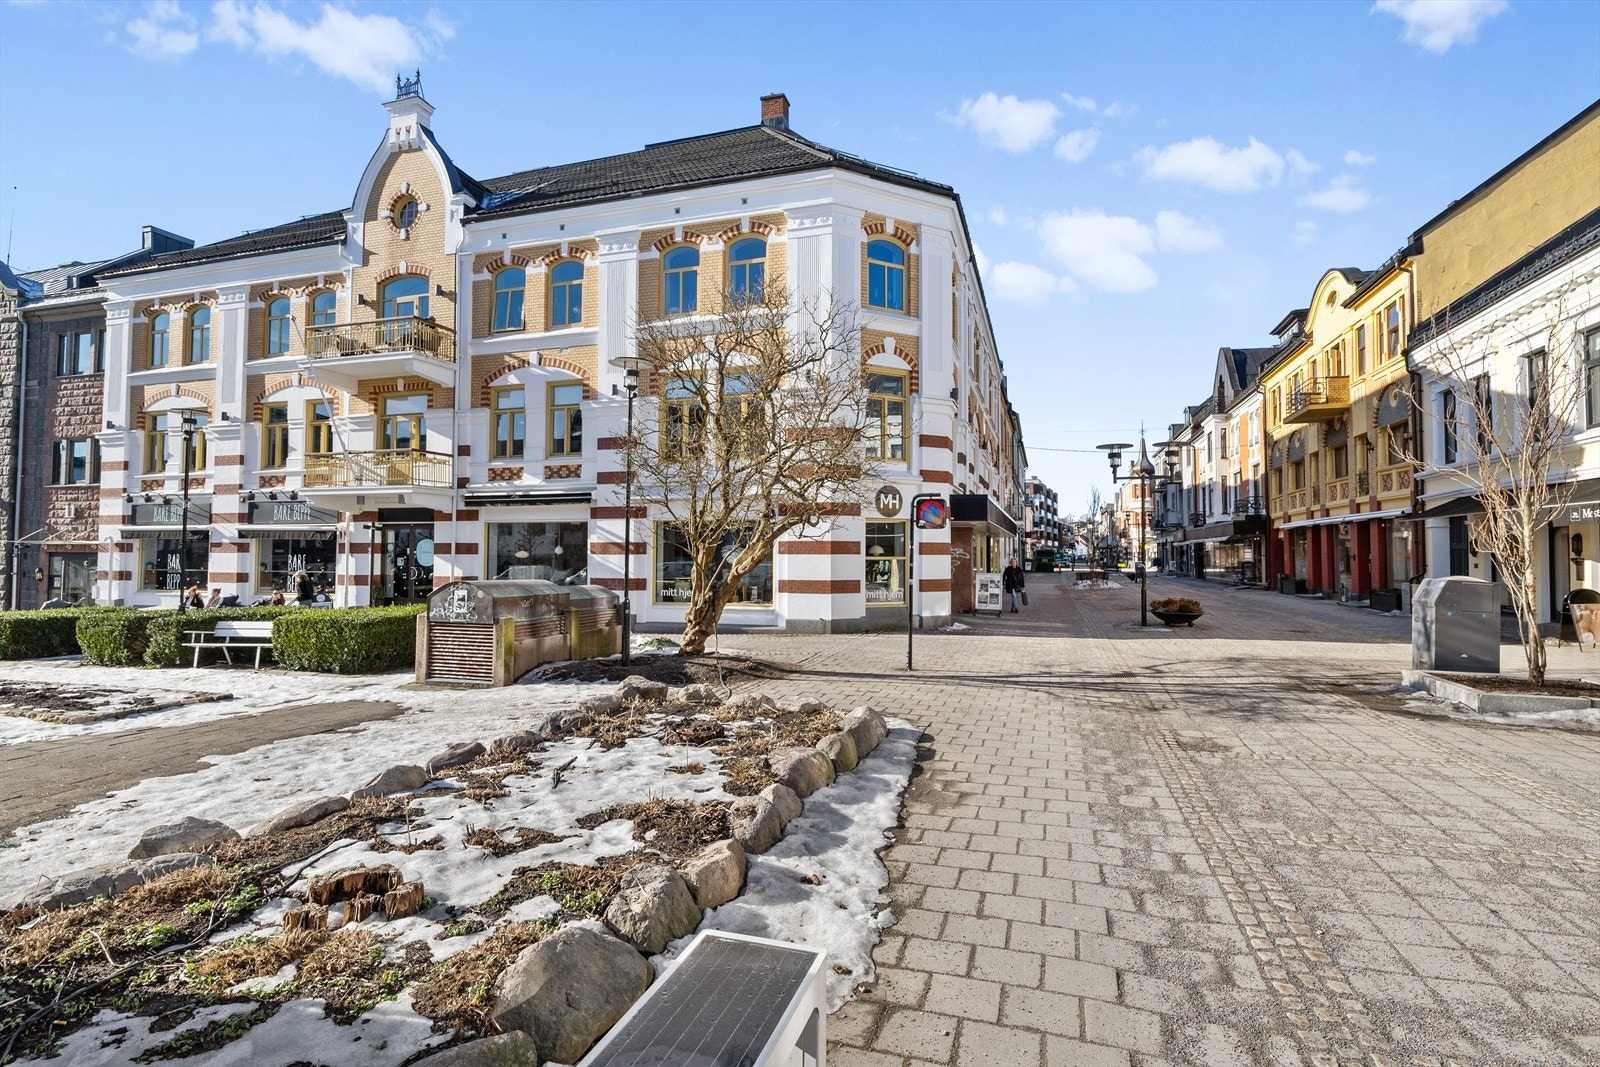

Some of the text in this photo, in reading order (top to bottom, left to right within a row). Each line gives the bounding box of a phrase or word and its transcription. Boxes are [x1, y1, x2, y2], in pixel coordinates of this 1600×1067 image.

[880, 493, 900, 510] MH
[171, 506, 184, 522] BEPP
[293, 504, 311, 521] BEPPE
[167, 553, 181, 570] BAR
[166, 573, 181, 590] BEPP
[660, 587, 692, 599] mitt hje
[866, 589, 904, 601] mitt hjem
